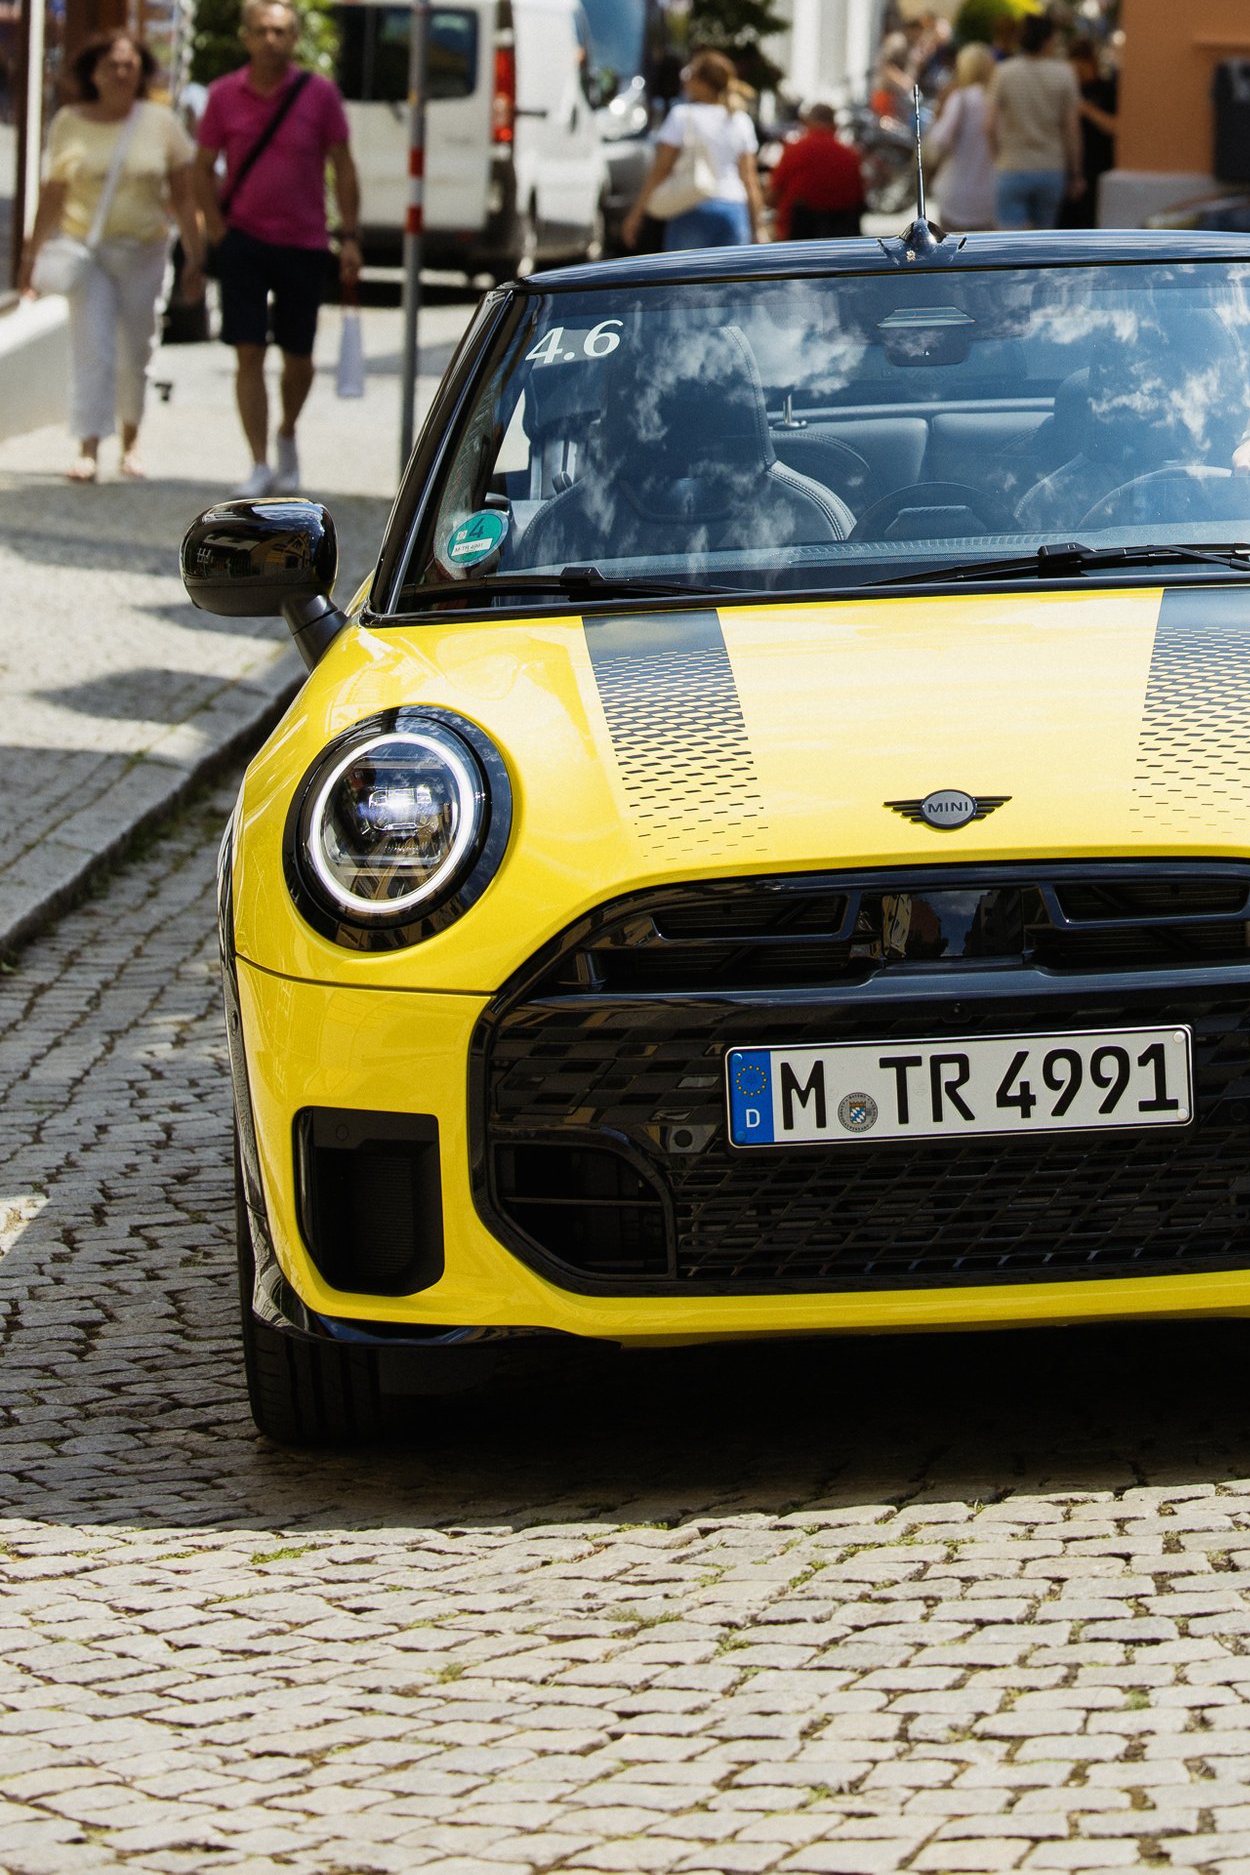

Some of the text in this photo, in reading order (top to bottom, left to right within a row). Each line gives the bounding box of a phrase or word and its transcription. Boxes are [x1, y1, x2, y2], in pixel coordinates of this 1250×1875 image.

[525, 319, 624, 364] 4.6
[469, 517, 485, 538] 4
[928, 801, 968, 813] MINI
[781, 1060, 827, 1130] M
[879, 1053, 975, 1125] TR
[996, 1042, 1180, 1119] 4991
[746, 1108, 760, 1127] D
